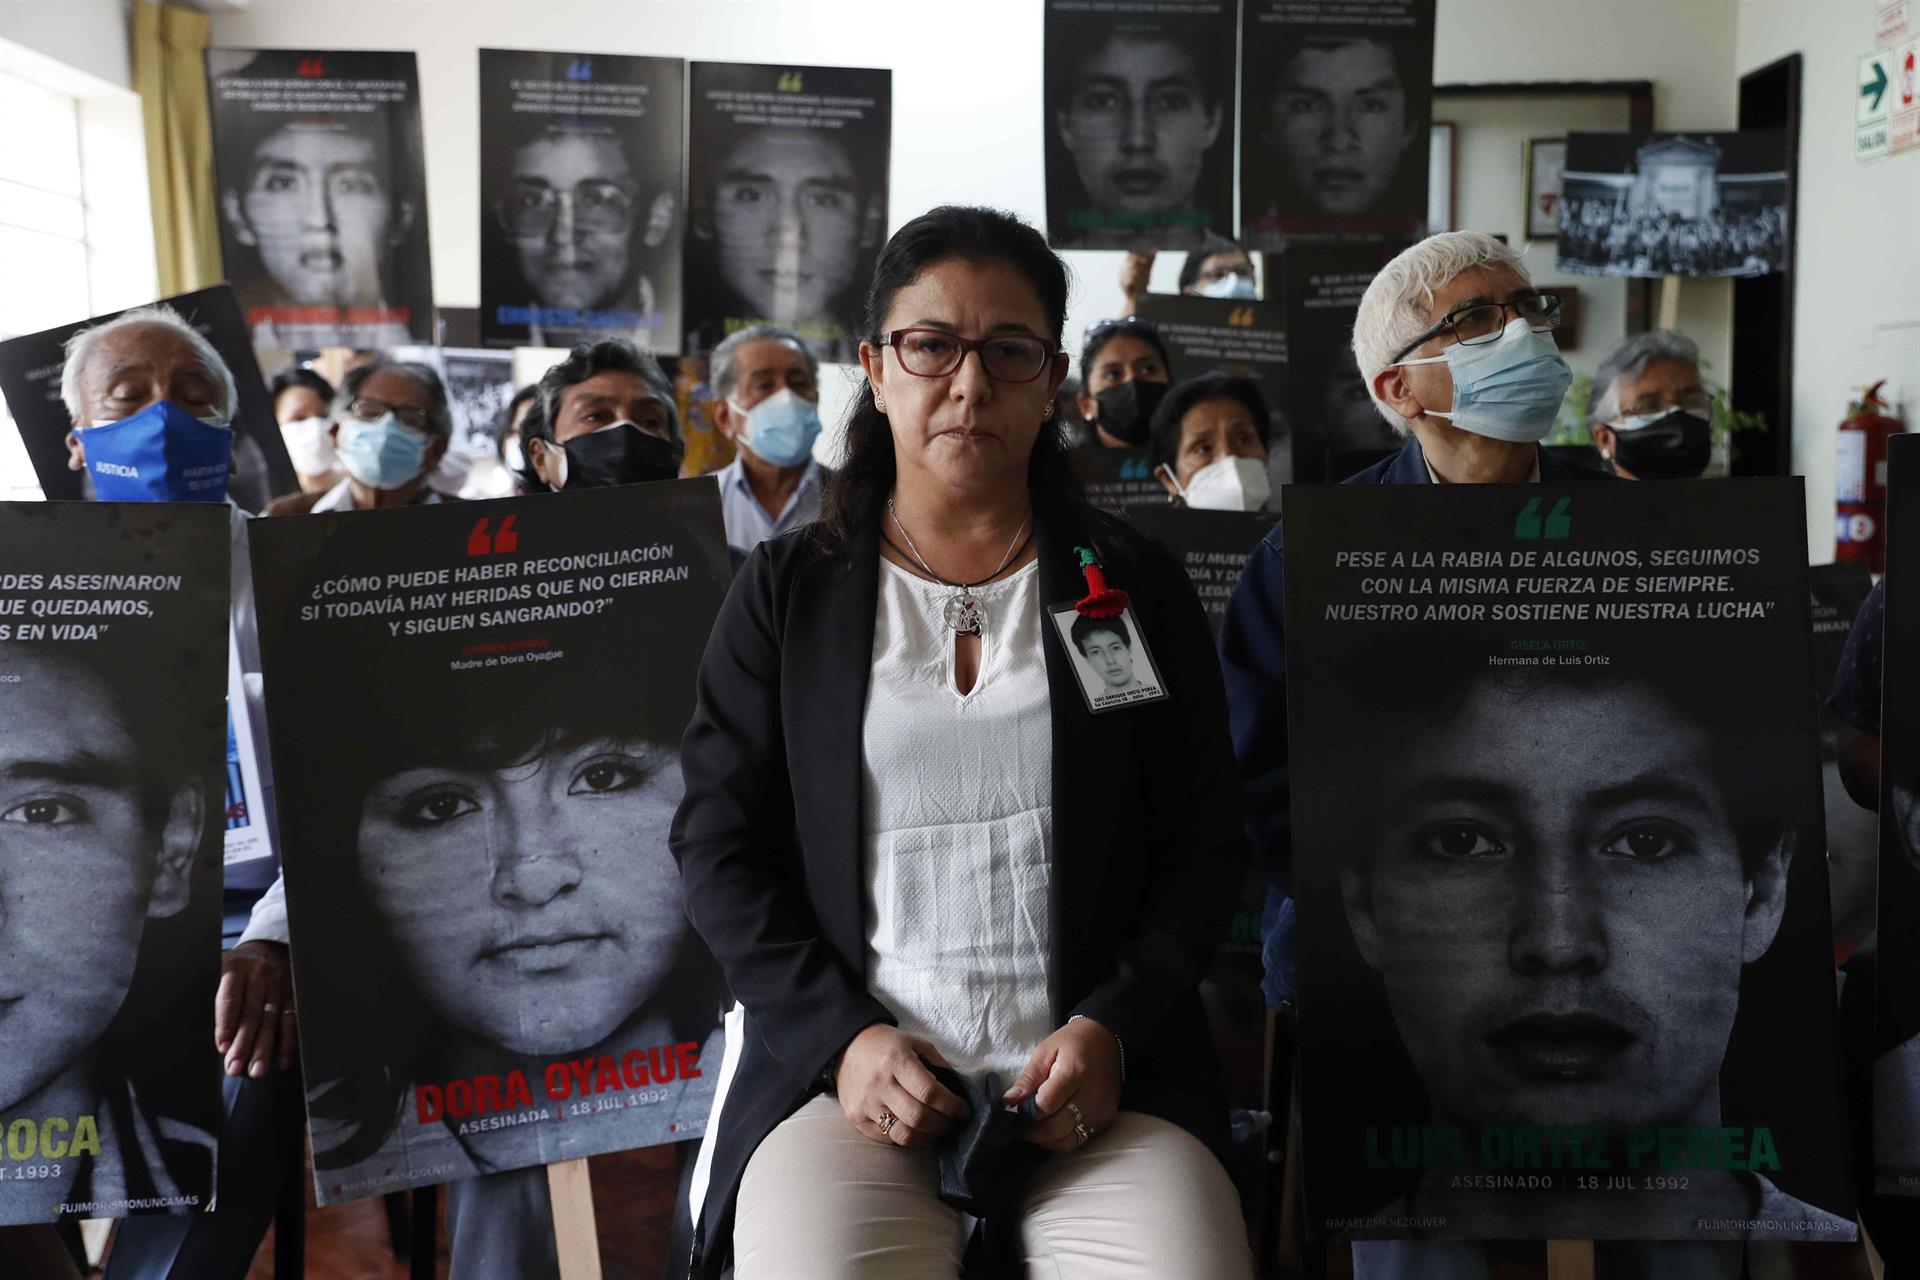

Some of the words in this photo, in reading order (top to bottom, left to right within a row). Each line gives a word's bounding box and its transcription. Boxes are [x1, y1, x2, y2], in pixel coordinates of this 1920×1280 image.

[96, 462, 139, 478] JUSTICIA
[1186, 552, 1205, 563] SU
[1336, 551, 1386, 568] PESE
[1391, 551, 1405, 567] A
[1411, 551, 1435, 567] LA
[1441, 551, 1503, 567] RABIA
[1509, 551, 1537, 567] DE
[1541, 550, 1643, 568] ALGUNOS,
[1649, 548, 1760, 566] SEGUIMOS
[312, 575, 381, 600] ¿CÓMO
[387, 569, 449, 589] PUEDE
[454, 562, 517, 583] HABER
[523, 543, 673, 575] RECONCILIACIÓN
[48, 574, 182, 590] ASESINARON
[1361, 578, 1403, 594] CON
[1409, 578, 1433, 594] LA
[1439, 578, 1510, 594] MISMA
[1515, 577, 1596, 594] FUERZA
[1602, 577, 1629, 593] DE
[1635, 575, 1734, 593] SIEMPRE.
[301, 605, 319, 620] SI
[325, 595, 404, 618] TODAVÍA
[410, 593, 446, 611] HAY
[451, 584, 531, 606] HERIDAS
[536, 579, 574, 598] QUE
[579, 576, 604, 592] NO
[609, 566, 688, 588] CIERRAN
[31, 599, 154, 618] QUEDAMOS,
[1324, 604, 1418, 621] NUESTRO
[1423, 604, 1485, 621] AMOR
[1491, 603, 1589, 621] SOSTIENE
[1595, 602, 1690, 620] NUESTRA
[1696, 601, 1775, 619] LUCHA”
[16, 624, 46, 640] EN
[51, 624, 108, 640] VIDA”
[388, 622, 400, 636] Y
[405, 614, 474, 635] SIGUEN
[1510, 640, 1552, 650] GISELA
[1553, 640, 1586, 650] ORTIZ
[450, 660, 483, 671] Madre
[485, 657, 498, 667] de
[500, 654, 524, 665] Dora
[526, 649, 564, 663] Oyague
[1489, 655, 1539, 665] Hermana
[1542, 655, 1556, 665] de
[1559, 655, 1582, 665] Luis
[1584, 655, 1611, 665] Ortiz
[0, 673, 21, 683] oca
[416, 1070, 532, 1125] DORA
[545, 1041, 702, 1101] OYAGUE
[458, 1109, 550, 1136] ASESINADA
[0, 1115, 101, 1160] OCA
[1365, 1124, 1467, 1169] LUIS
[1481, 1124, 1612, 1169] ORTIZ
[1451, 1176, 1553, 1189] ASESINADO
[1577, 1176, 1599, 1190] 18
[1606, 1176, 1636, 1190] JUL
[1644, 1176, 1690, 1190] 1992
